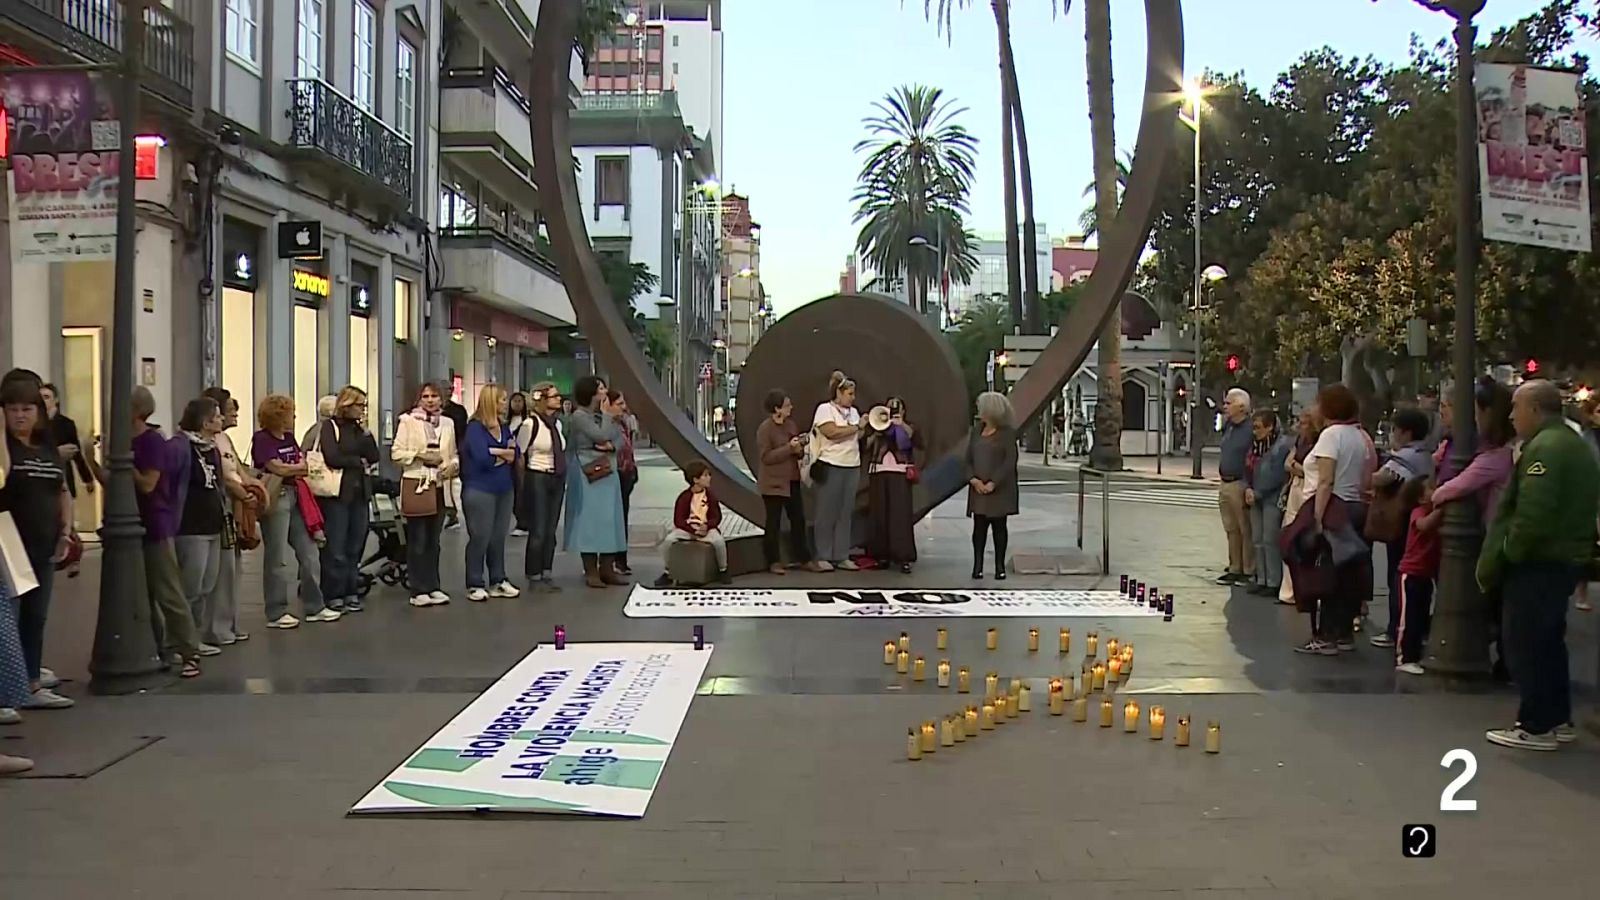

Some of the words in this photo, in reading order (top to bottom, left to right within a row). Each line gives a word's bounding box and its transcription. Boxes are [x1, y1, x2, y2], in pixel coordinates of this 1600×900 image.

[806, 591, 972, 605] NO
[568, 659, 627, 699] MACHISTA
[459, 706, 540, 758] HOMBRES
[515, 669, 573, 703] CONTRA
[518, 701, 596, 759] VIOLENCIA
[501, 761, 549, 779] LA
[559, 747, 619, 785] ahige
